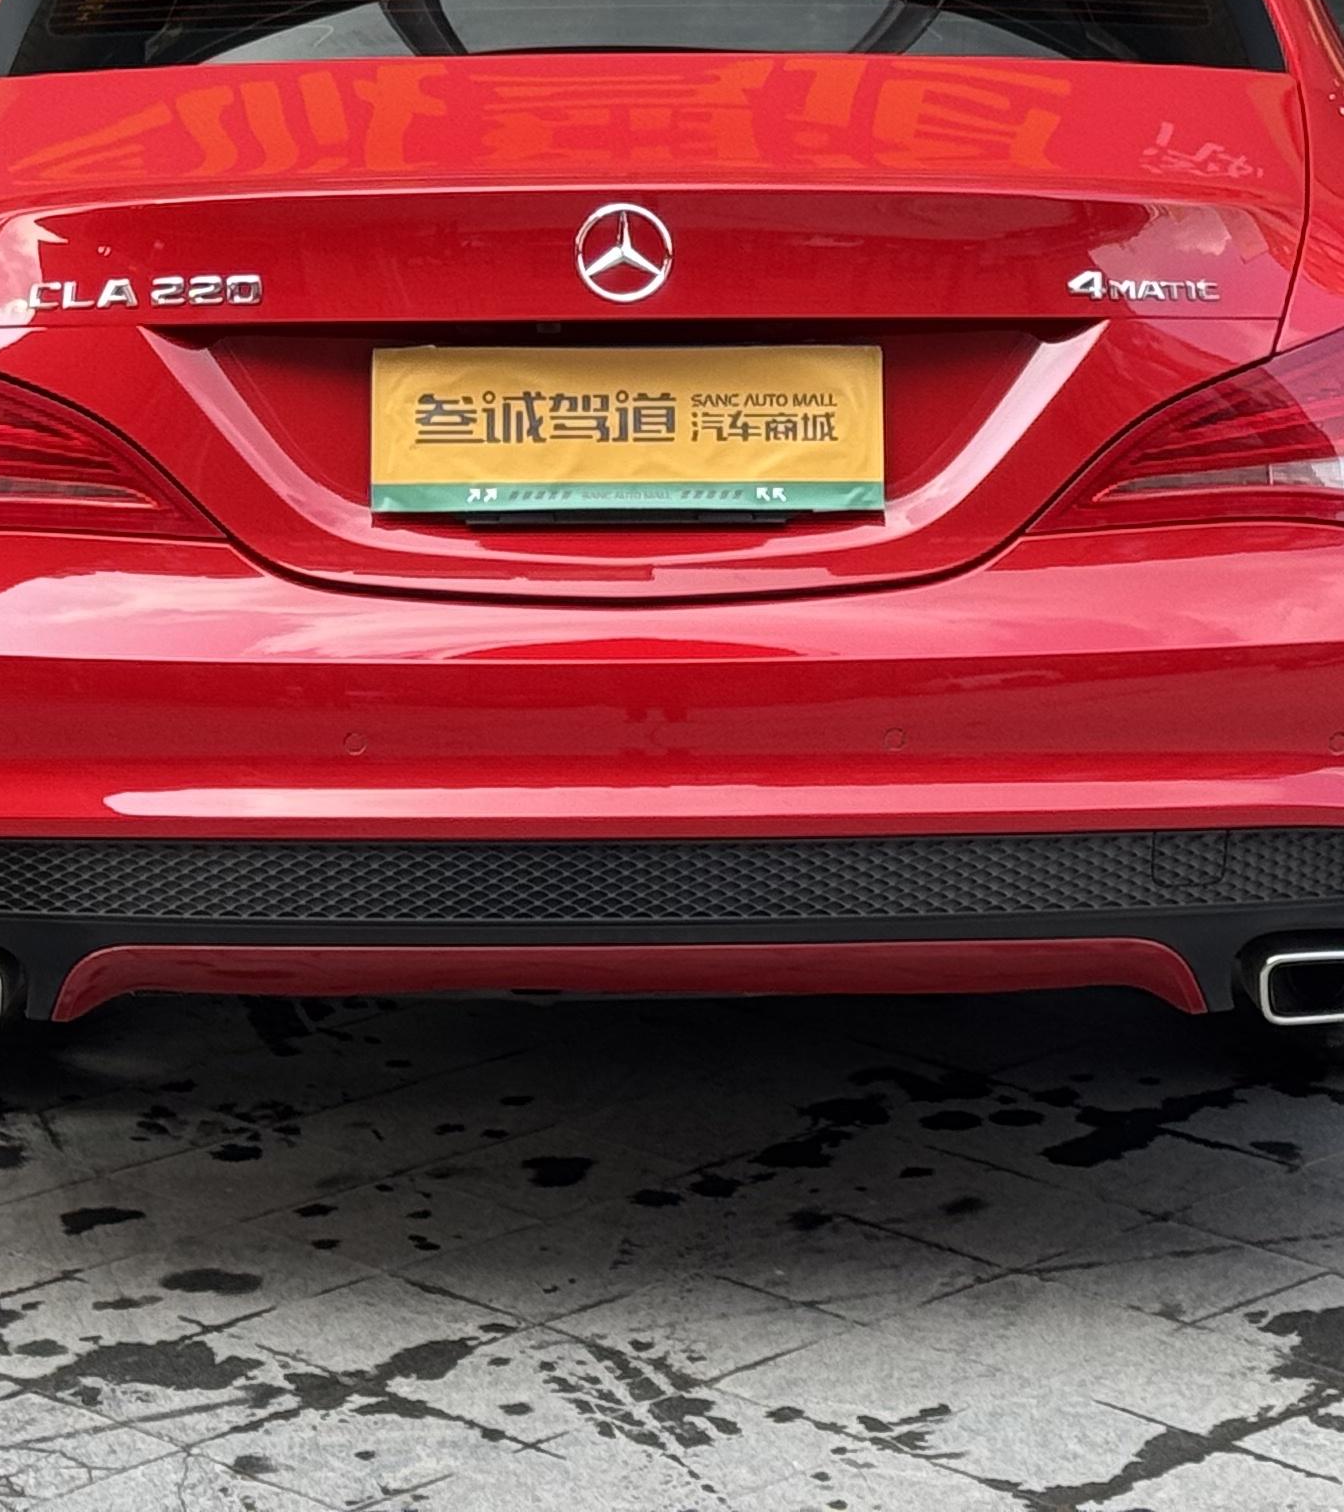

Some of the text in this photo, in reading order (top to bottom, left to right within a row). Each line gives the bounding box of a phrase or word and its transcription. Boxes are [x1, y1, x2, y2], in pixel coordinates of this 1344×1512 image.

[27, 274, 263, 311] CLA 220
[1066, 268, 1221, 302] 4MATIC
[414, 389, 677, 444] 叁诚驾道
[691, 392, 838, 408] SANC AUTO MALL
[690, 409, 839, 443] 汽车商城
